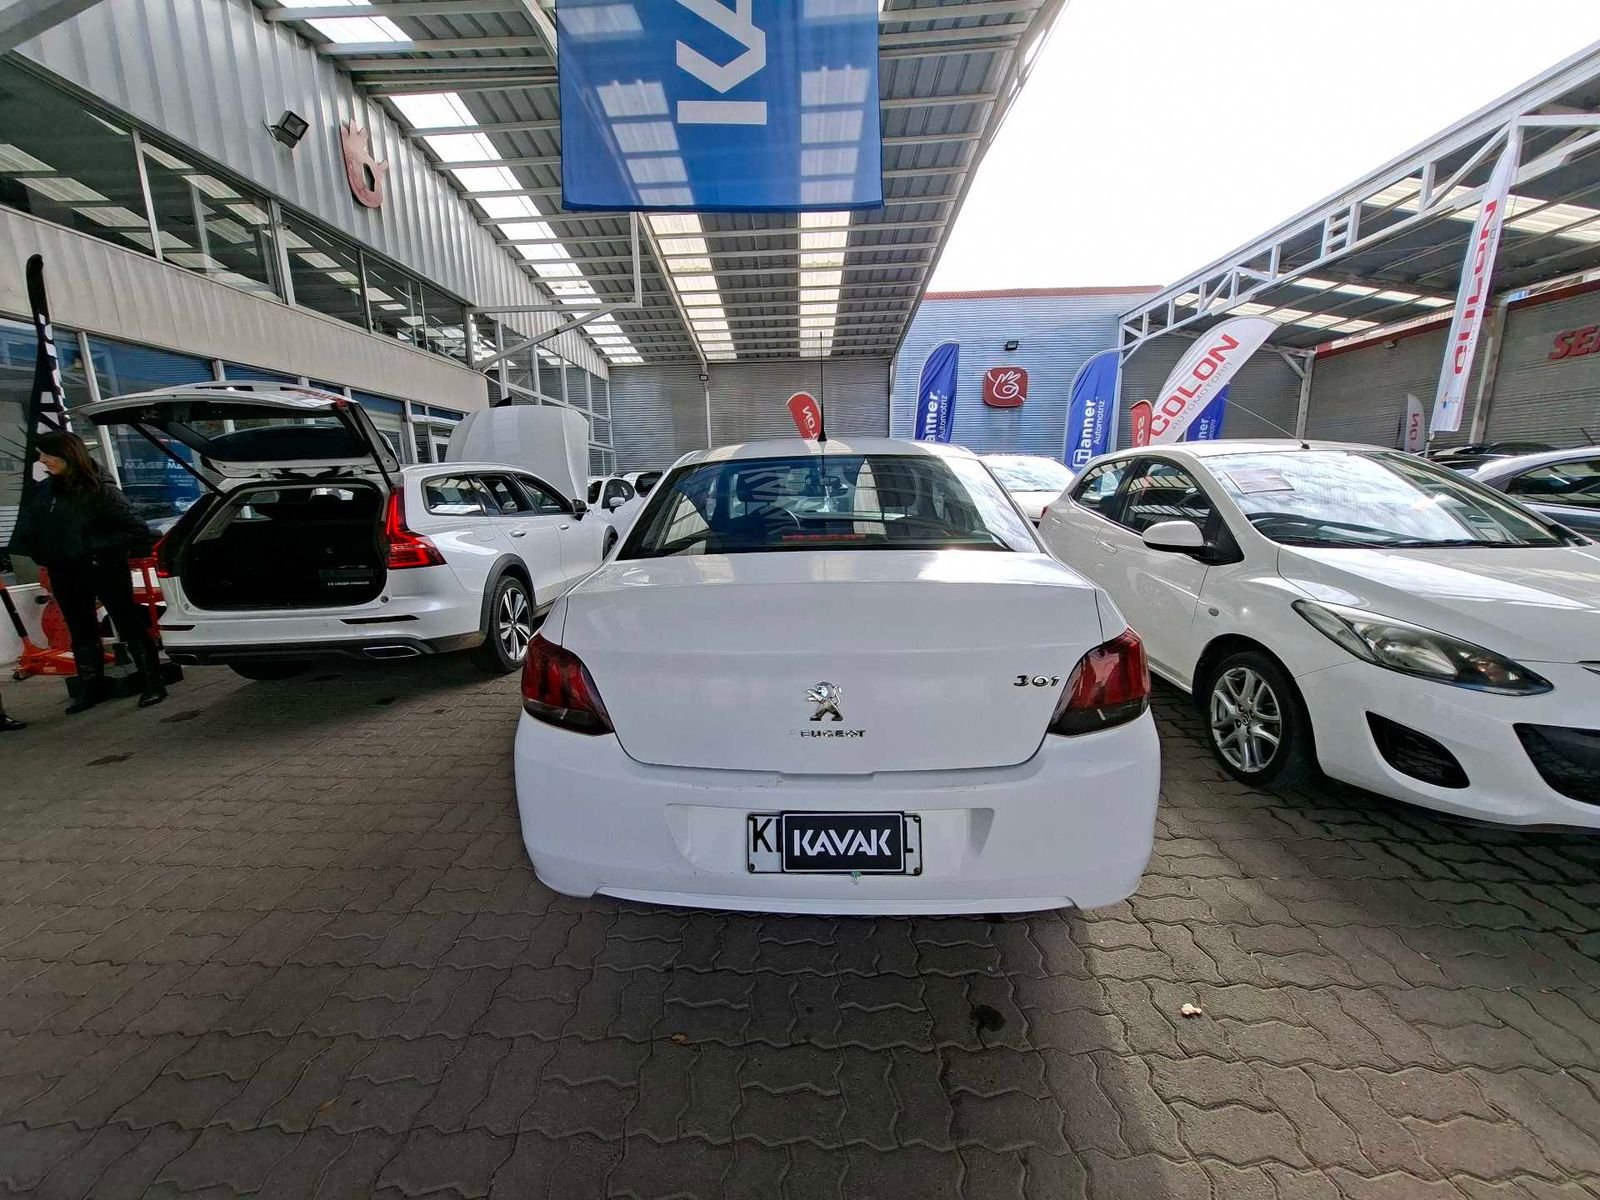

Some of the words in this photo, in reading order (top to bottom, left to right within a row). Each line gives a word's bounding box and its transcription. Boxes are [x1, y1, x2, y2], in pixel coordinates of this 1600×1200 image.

[1548, 324, 1600, 359] SE
[1150, 334, 1240, 436] COLON
[938, 395, 948, 439] Automotriz
[1093, 400, 1105, 444] Automotriz
[1013, 675, 1060, 687] 301
[788, 729, 866, 738] EUGEOT
[793, 829, 892, 856] KAVAK
